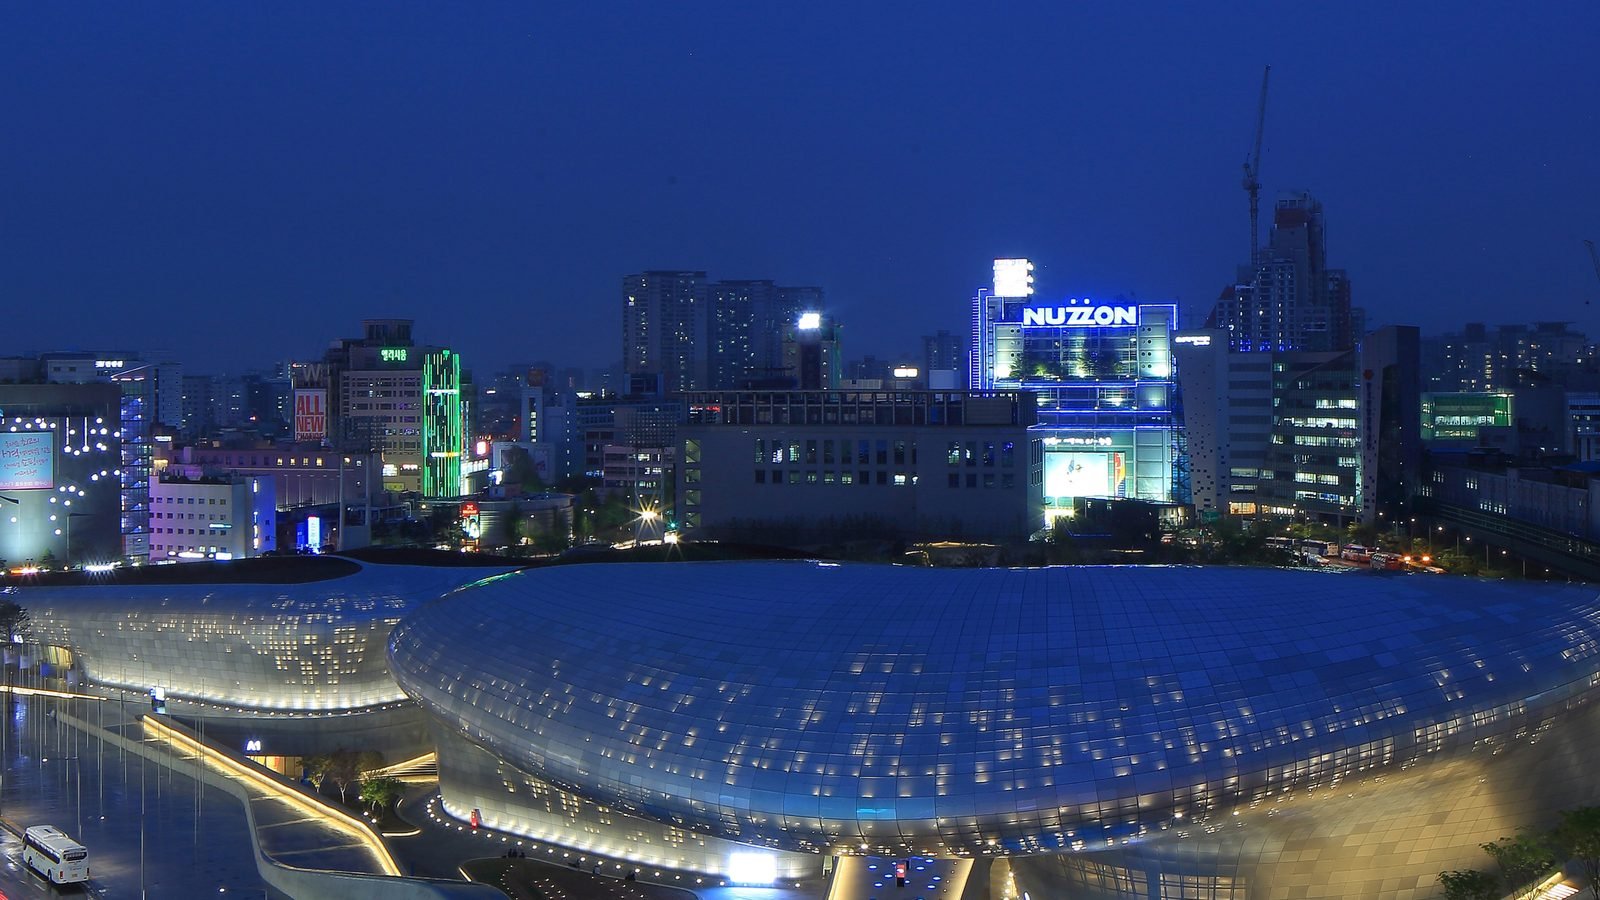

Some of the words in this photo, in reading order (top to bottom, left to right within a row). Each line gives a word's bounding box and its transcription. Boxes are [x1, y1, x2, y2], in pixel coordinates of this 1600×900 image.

[1023, 303, 1137, 325] NUZZON
[296, 395, 324, 415] ALL
[296, 416, 324, 432] NEW
[246, 740, 261, 751] A1
